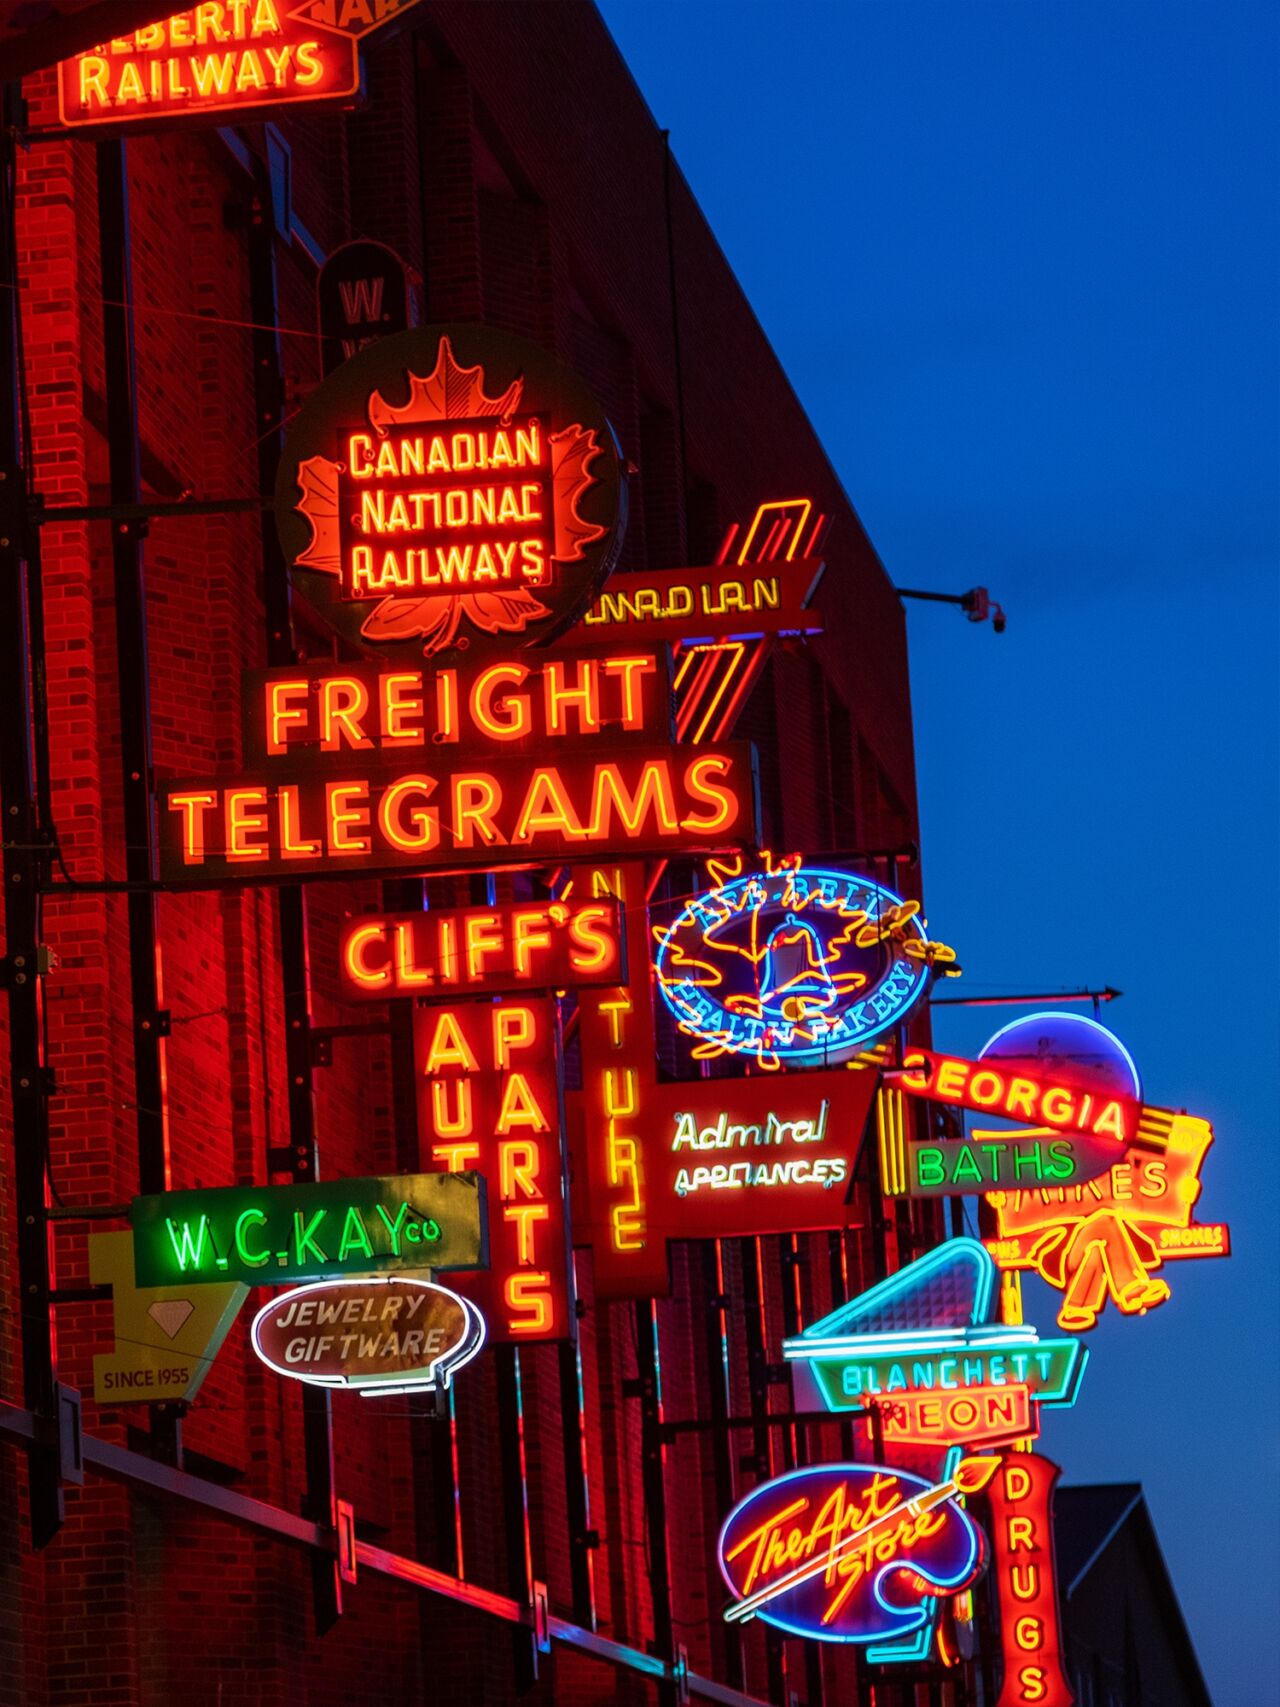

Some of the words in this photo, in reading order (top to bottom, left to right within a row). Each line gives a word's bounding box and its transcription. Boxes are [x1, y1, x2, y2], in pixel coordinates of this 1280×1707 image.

[78, 42, 324, 109] RAILWAYS
[348, 425, 542, 480] CANADIAN
[358, 485, 542, 535] NATIONAL
[351, 540, 546, 592] RAILWAYS
[585, 576, 782, 625] NADIAN
[265, 654, 656, 755] FREIGHT
[167, 754, 740, 865] TELEGRAMS
[344, 903, 616, 988] CLIFF'S
[425, 1012, 479, 1174] AUT
[900, 1053, 1126, 1142] GEORGIA
[671, 1098, 830, 1152] Admiral
[492, 1006, 554, 1341] PARTS
[917, 1140, 1076, 1186] BATHS
[276, 1294, 426, 1329] JEWELRY
[284, 1328, 446, 1364] GIFTWARE
[103, 1369, 153, 1390] SINCE
[156, 1367, 190, 1387] 1955
[842, 1353, 1052, 1396] BLANCHETT
[882, 1392, 1017, 1435] NEON
[726, 1497, 810, 1596] The
[798, 1472, 904, 1589] Art
[1005, 1466, 1048, 1700] DRUGS
